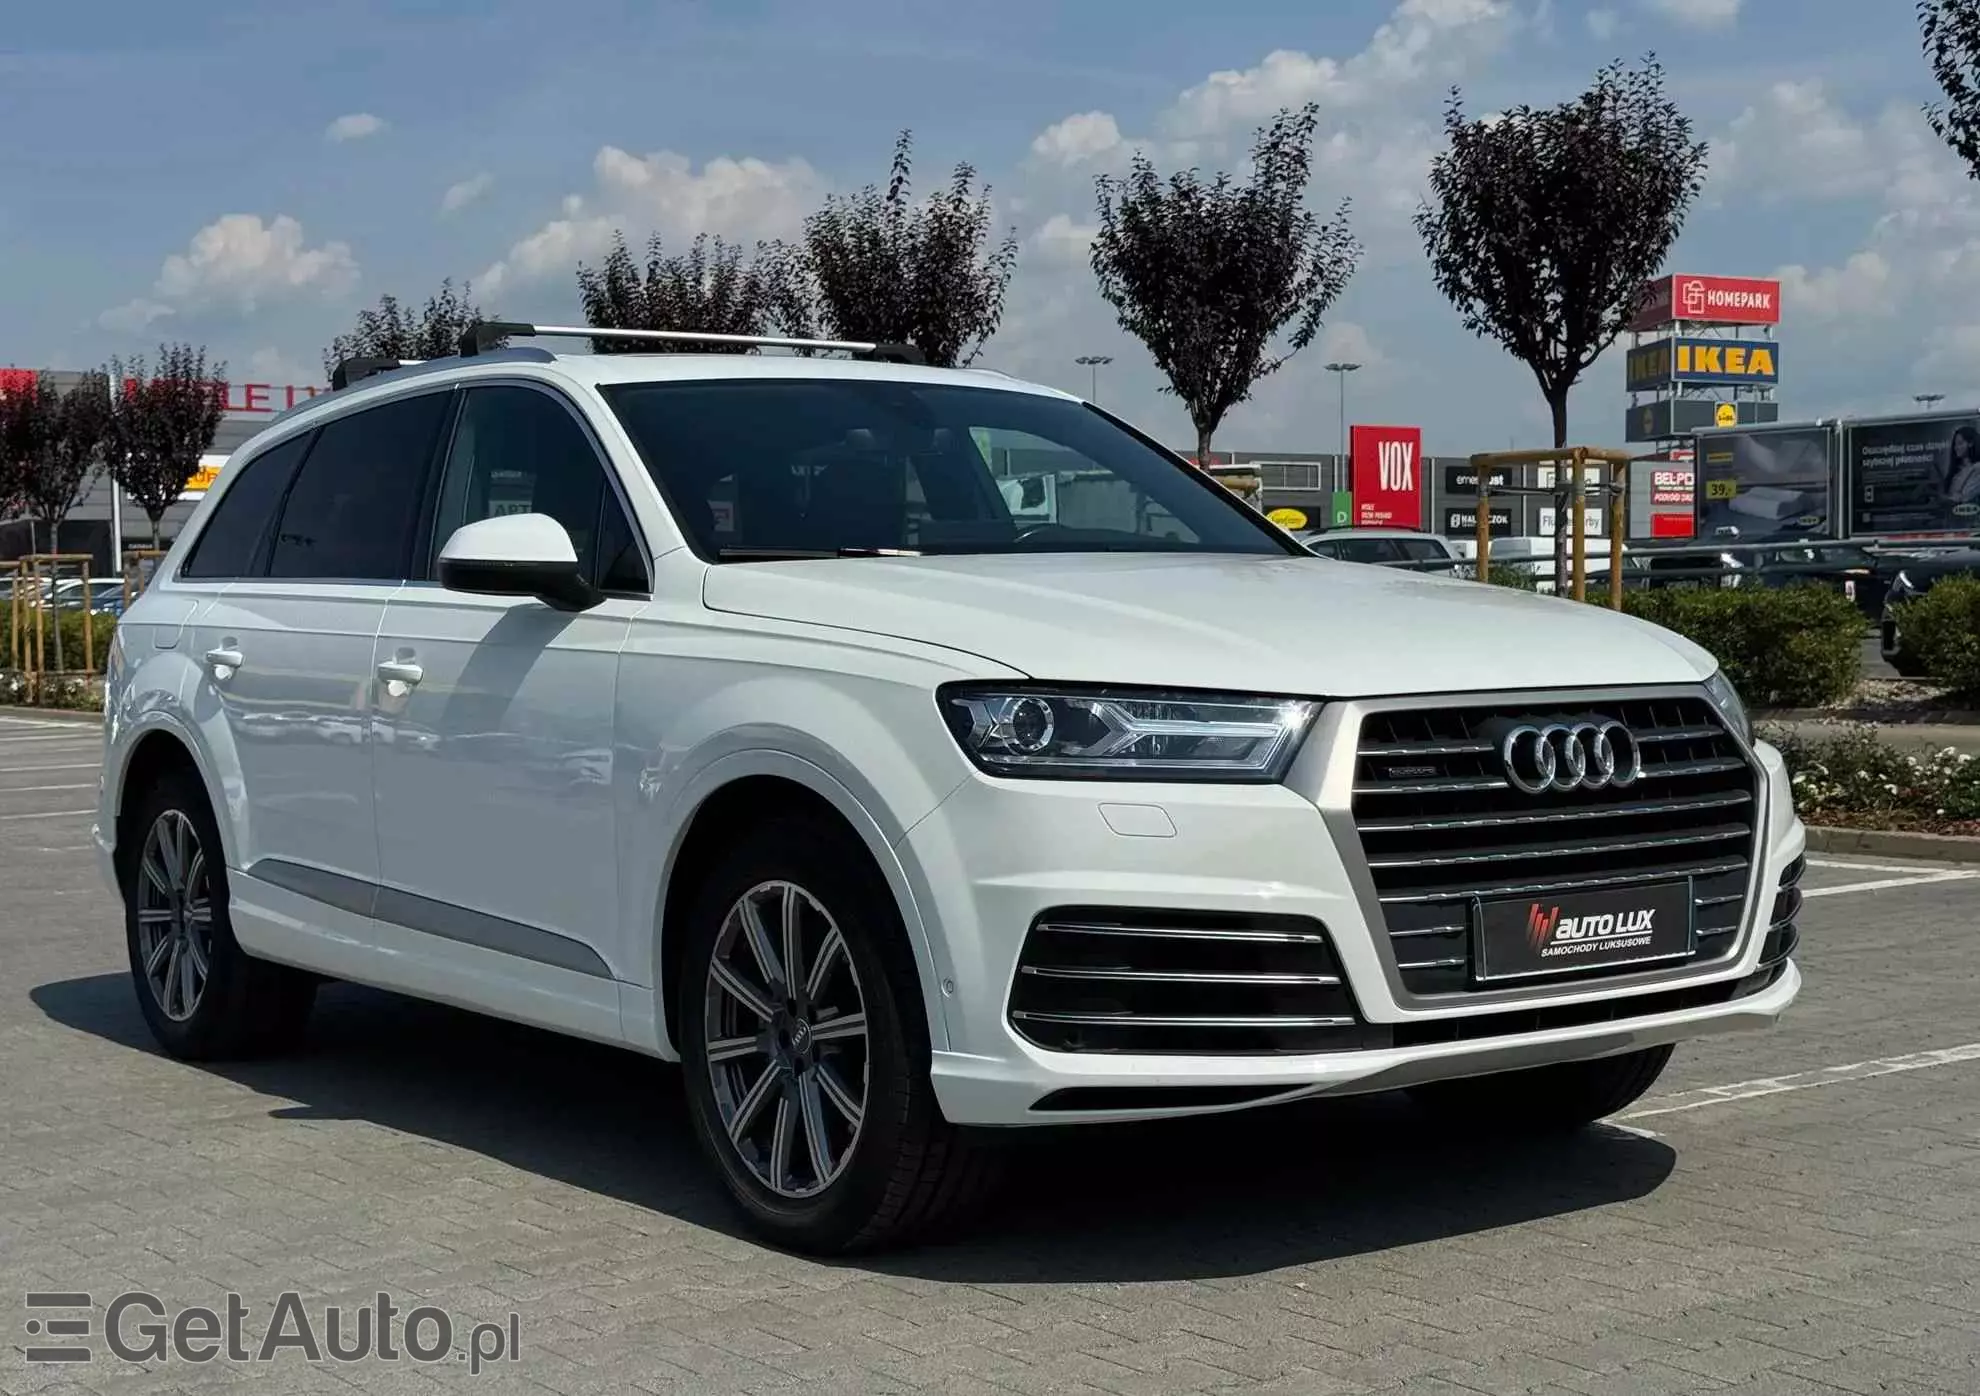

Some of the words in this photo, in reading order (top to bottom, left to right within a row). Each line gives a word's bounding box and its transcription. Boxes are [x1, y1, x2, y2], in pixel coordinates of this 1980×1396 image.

[1707, 290, 1771, 309] HOMEPARK
[1677, 345, 1775, 376] IKEA
[1378, 441, 1414, 491] VOX
[1654, 471, 1695, 486] BEL-PO
[1337, 511, 1348, 523] D
[1462, 514, 1508, 525] HALCZOK
[1616, 909, 1656, 933] LUX
[1541, 942, 1598, 957] SAMOCHODY
[1599, 936, 1651, 951] LUKSUSOWE
